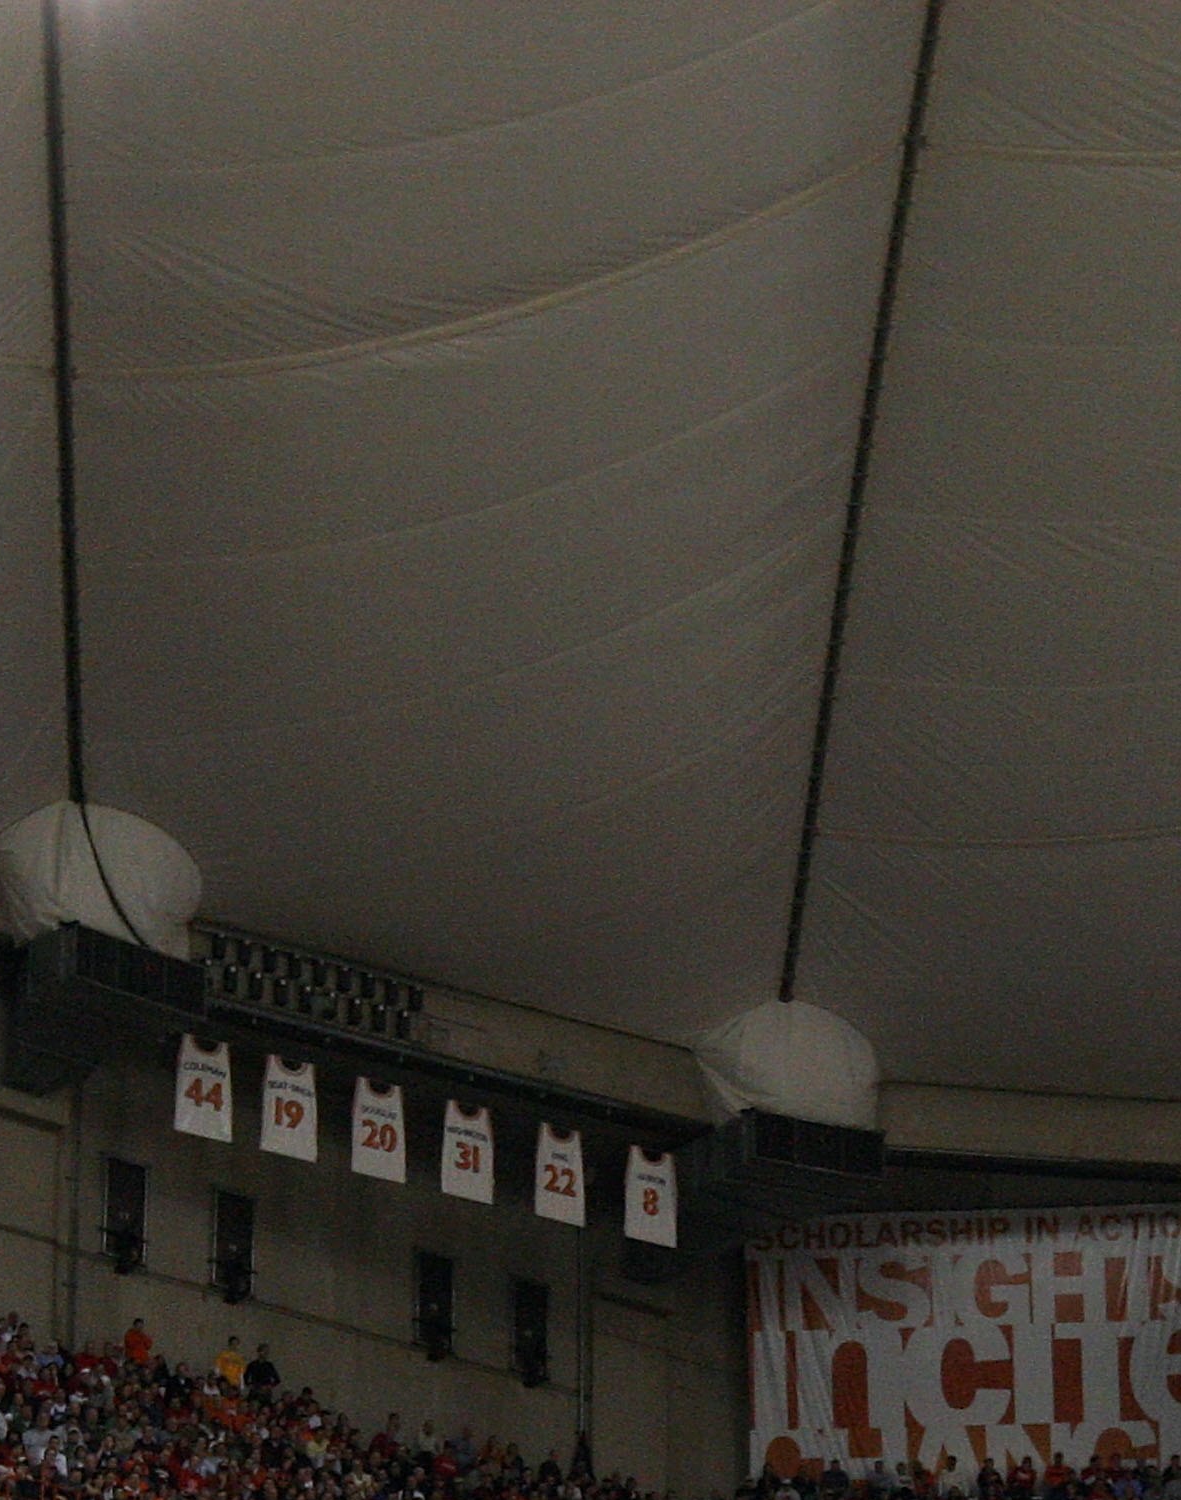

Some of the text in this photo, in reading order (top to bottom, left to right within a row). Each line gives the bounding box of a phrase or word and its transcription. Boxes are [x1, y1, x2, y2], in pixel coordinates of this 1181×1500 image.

[185, 1077, 224, 1112] 44
[274, 1096, 305, 1130] 19
[362, 1119, 398, 1154] 20
[454, 1141, 481, 1174] 31
[543, 1163, 577, 1198] 22
[642, 1187, 660, 1216] 8
[754, 1217, 1011, 1251] SCHOLARSHIP
[1024, 1214, 1061, 1243] IN
